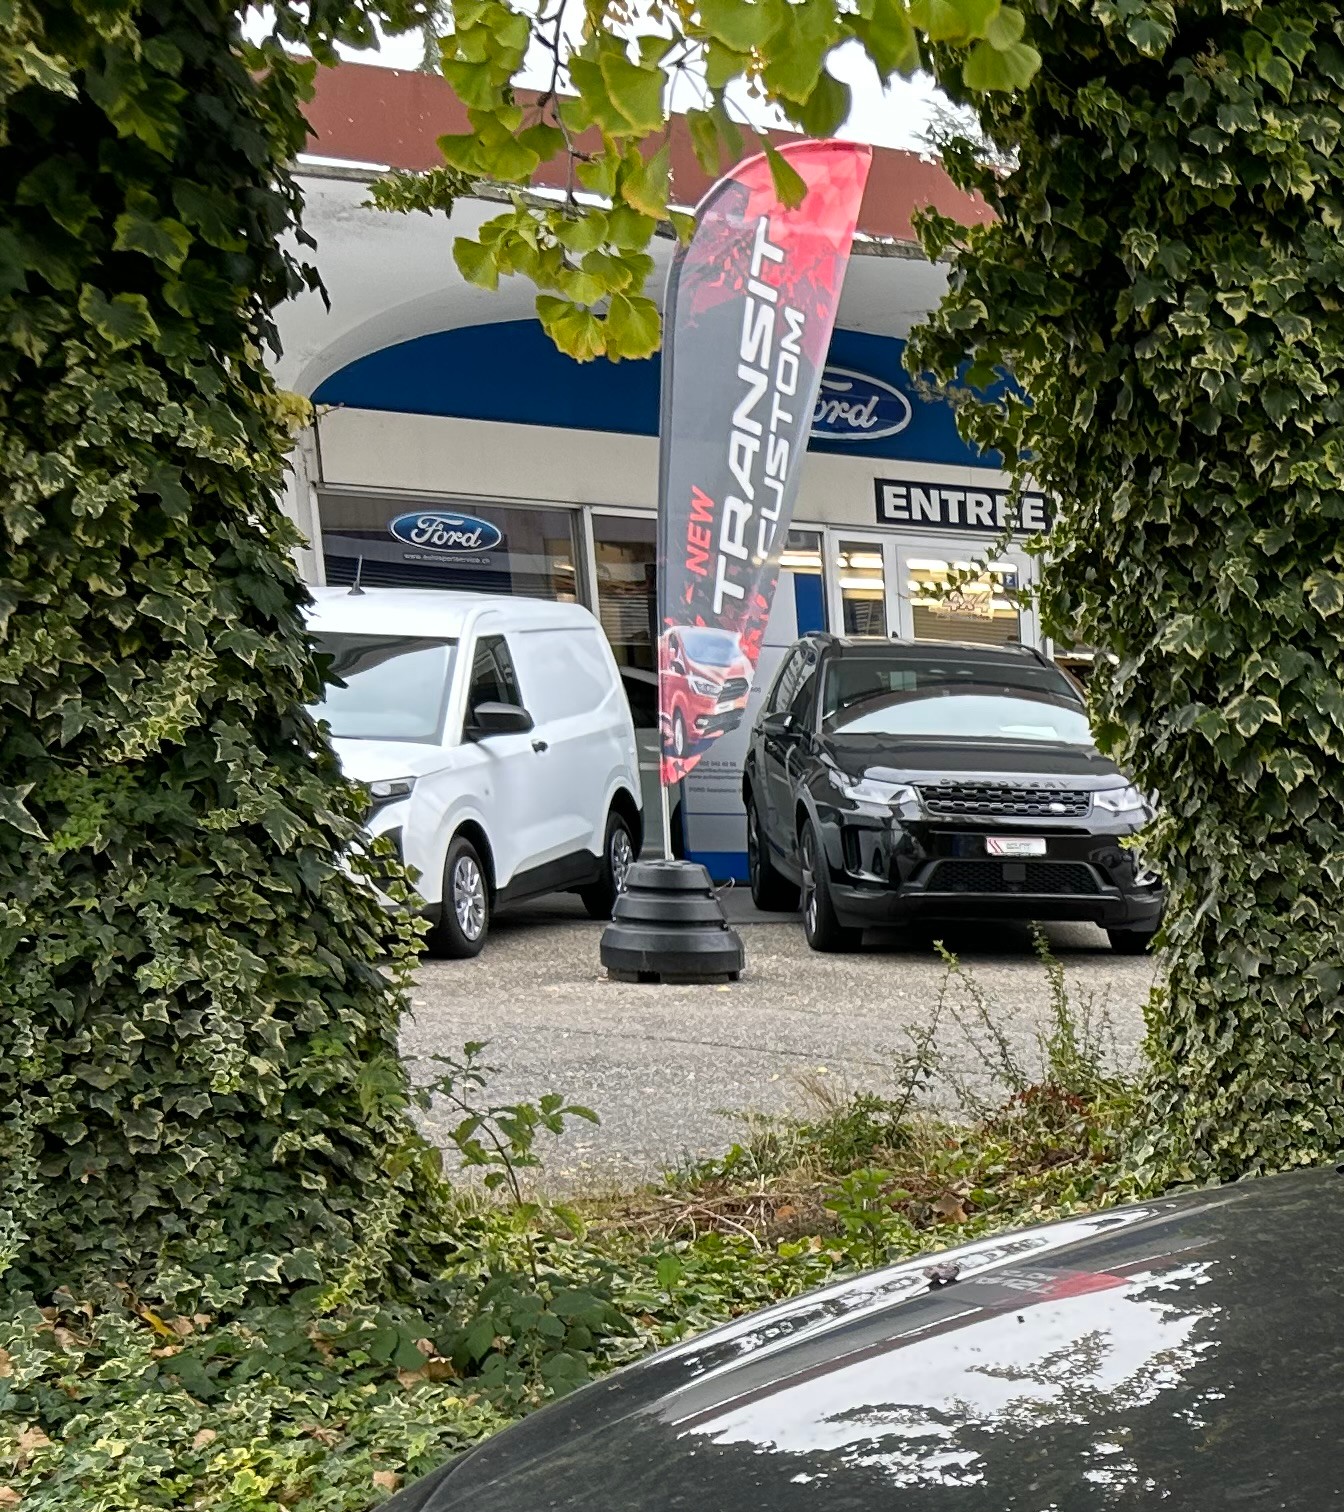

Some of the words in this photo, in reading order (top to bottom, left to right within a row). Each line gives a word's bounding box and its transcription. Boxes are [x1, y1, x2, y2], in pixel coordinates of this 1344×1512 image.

[713, 216, 784, 615] TRANSIT
[756, 306, 805, 560] CUSTOM
[411, 515, 482, 548] Ford
[685, 485, 715, 577] NEW
